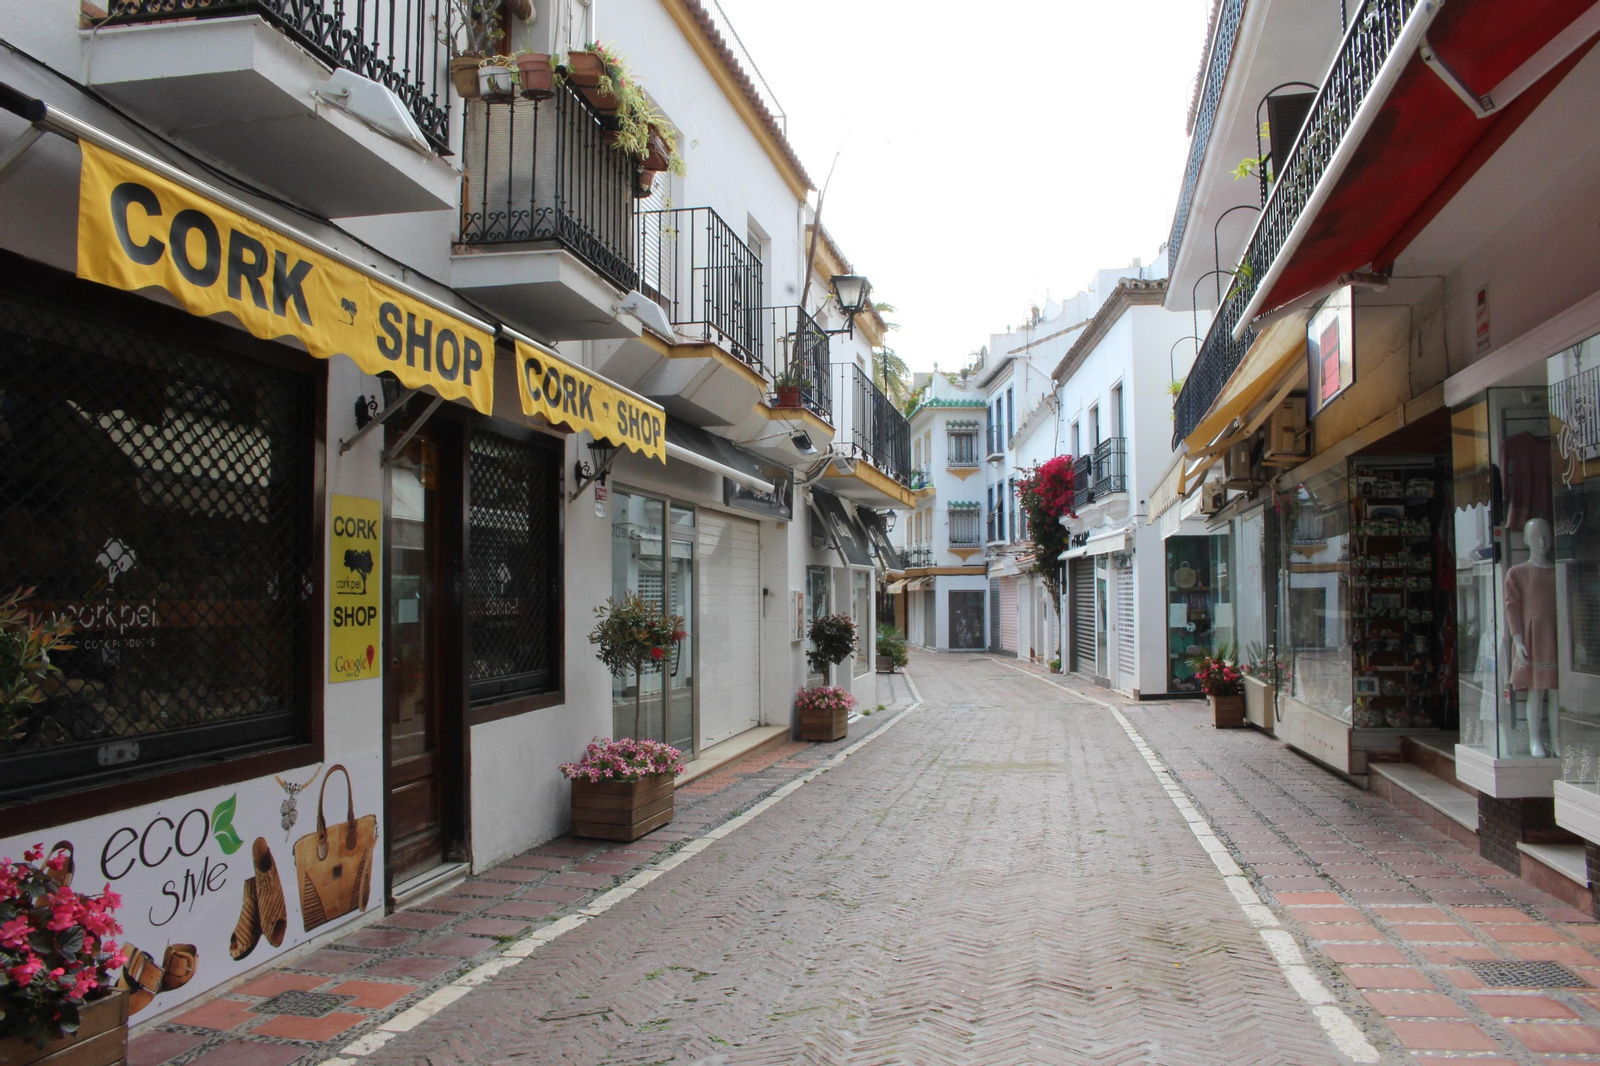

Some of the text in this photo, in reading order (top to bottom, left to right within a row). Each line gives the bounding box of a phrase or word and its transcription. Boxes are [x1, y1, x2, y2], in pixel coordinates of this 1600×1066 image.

[110, 182, 483, 386] CORK SHOP
[524, 357, 661, 448] CORK SHOP
[333, 515, 378, 540] CORK
[333, 606, 377, 628] SHOP
[335, 653, 367, 677] Google
[100, 808, 210, 881] eco
